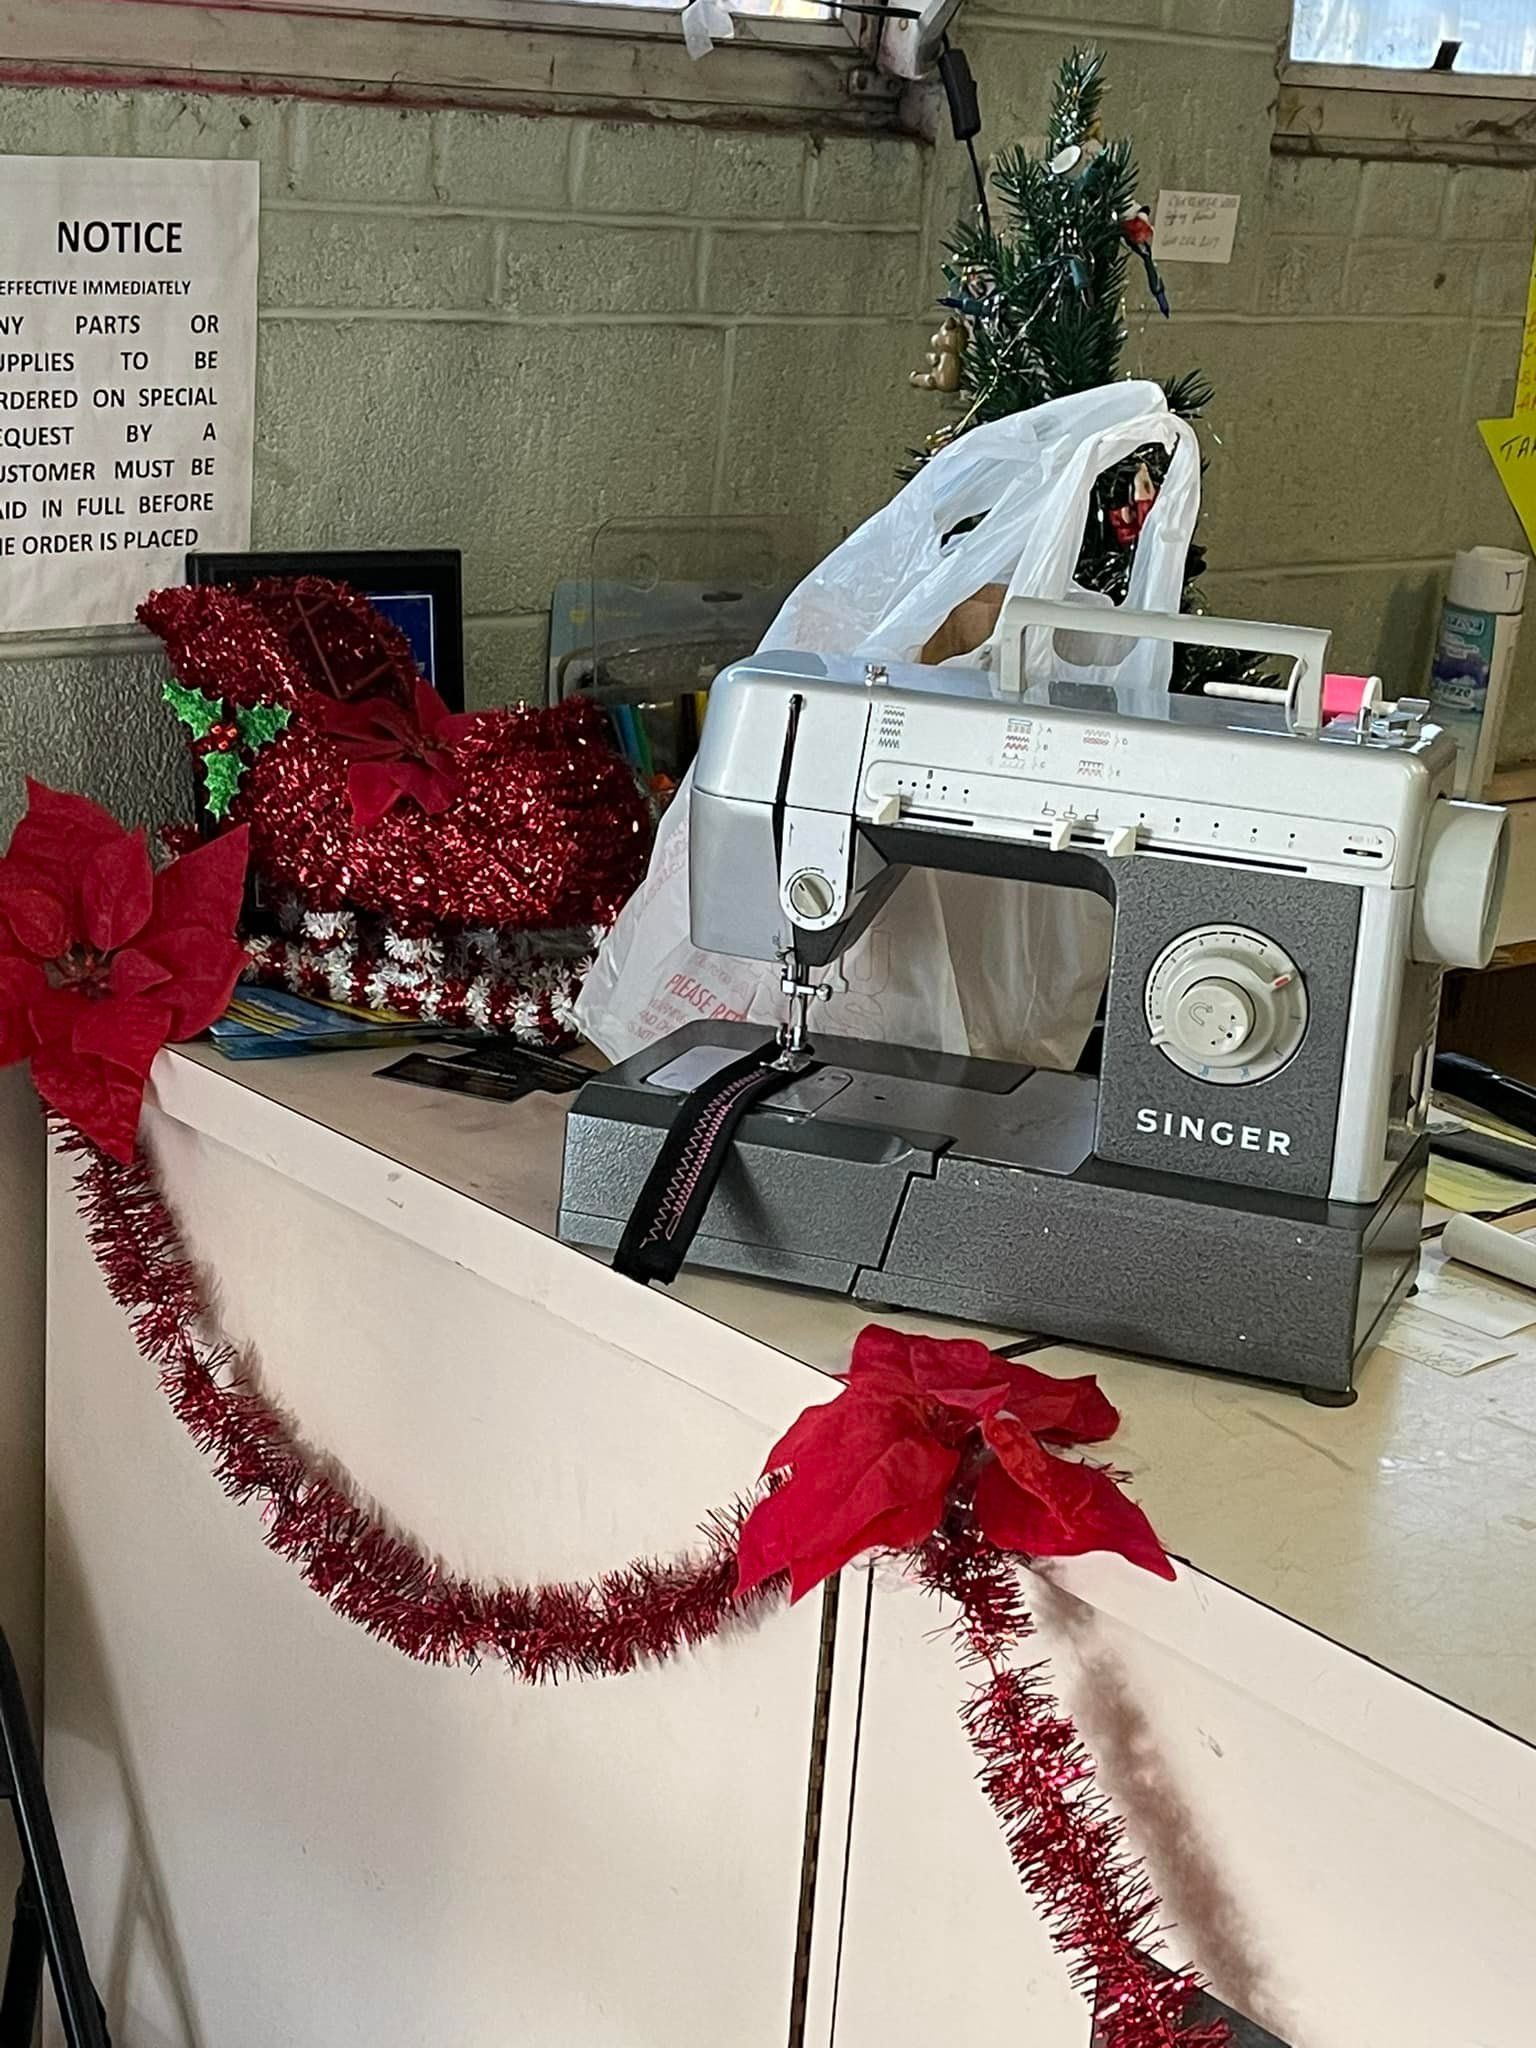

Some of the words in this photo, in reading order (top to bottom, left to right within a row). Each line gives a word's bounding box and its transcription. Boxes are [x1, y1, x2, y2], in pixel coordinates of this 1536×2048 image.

[58, 221, 182, 253] NOTICE
[0, 281, 77, 295] EFFECTIVE
[84, 281, 191, 295] IMMEDIATELY
[76, 315, 140, 334] PARTS
[191, 315, 219, 334] OR
[121, 352, 148, 370] TO
[195, 351, 218, 369] BE
[93, 389, 125, 407] ON
[139, 387, 218, 407] SPECIAL
[0, 427, 74, 449] QUEST
[127, 424, 152, 442] BY
[203, 422, 216, 440] A
[115, 460, 175, 479] MUST
[192, 458, 215, 475] BE
[43, 499, 62, 518] IN
[78, 497, 125, 516] FULL
[140, 493, 214, 513] BEFORE
[0, 537, 15, 556] E
[23, 534, 93, 554] ORDER
[101, 532, 117, 550] IS
[125, 528, 198, 549] PLACED
[665, 973, 717, 1014] PLEASE
[1136, 1108, 1291, 1156] SINGER
